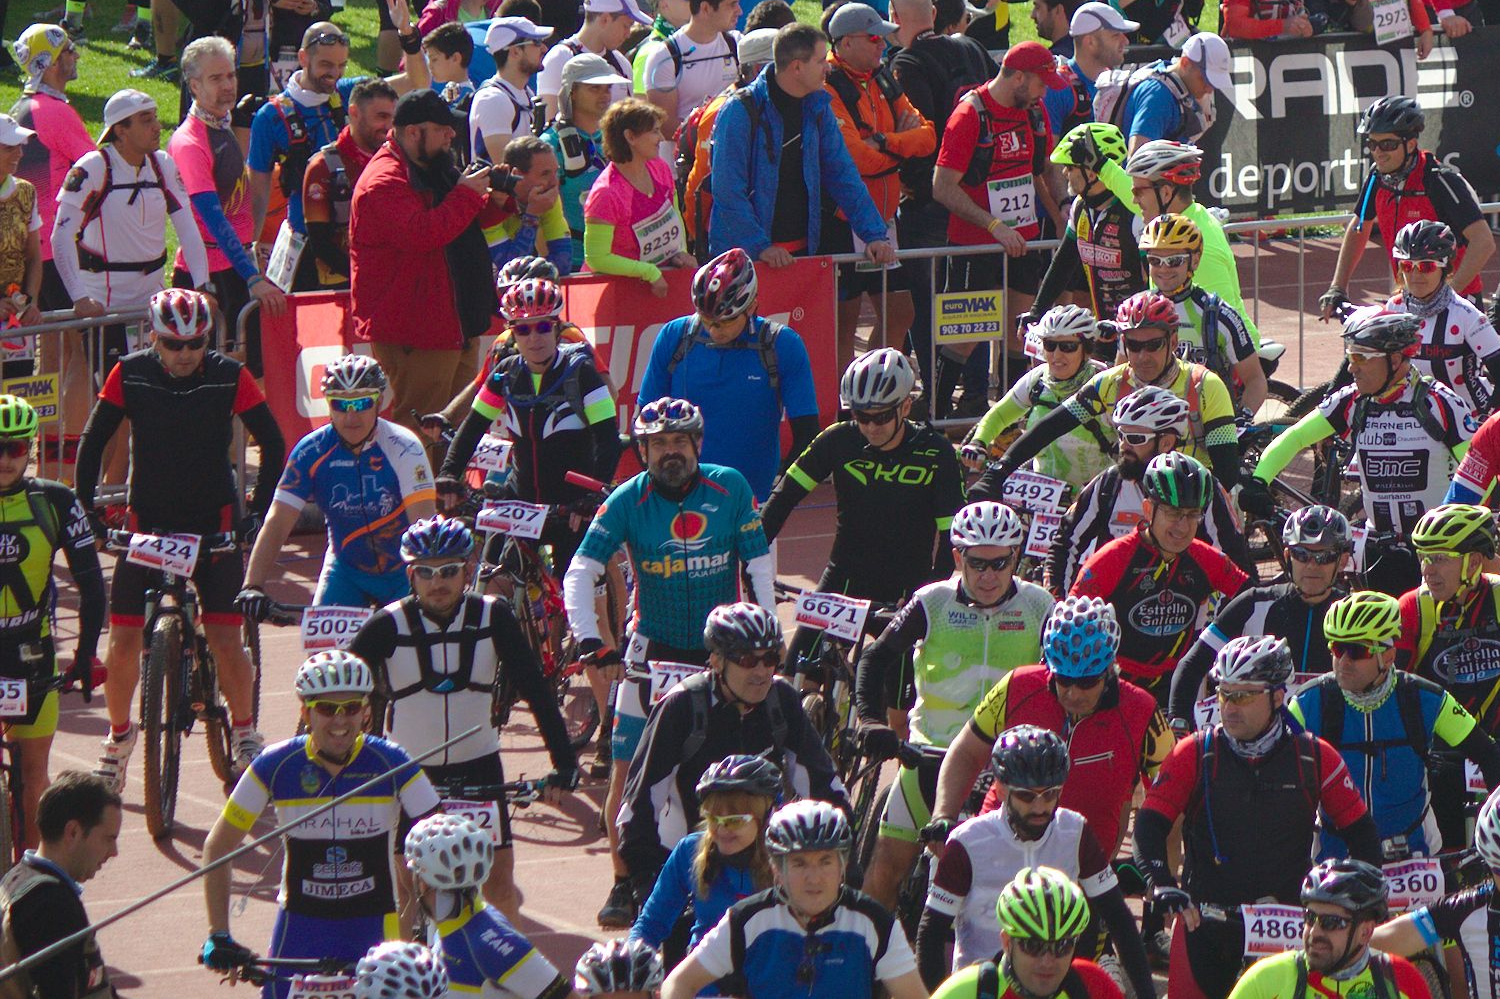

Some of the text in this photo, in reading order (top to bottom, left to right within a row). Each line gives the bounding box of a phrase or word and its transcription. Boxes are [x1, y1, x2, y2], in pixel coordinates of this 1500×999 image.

[1375, 9, 1406, 28] 2973
[1209, 150, 1461, 197] deportis
[999, 193, 1030, 213] 212
[643, 225, 680, 257] 8239
[942, 322, 997, 336] 902 70 22 23
[1002, 480, 1055, 503] 6492
[740, 519, 763, 532] caja
[642, 551, 730, 579] cajamar
[803, 598, 858, 625] 6671
[1137, 602, 1188, 617] Estrella
[306, 618, 363, 636] 5005
[1141, 614, 1185, 630] Galicia
[304, 881, 371, 897] JIMECA
